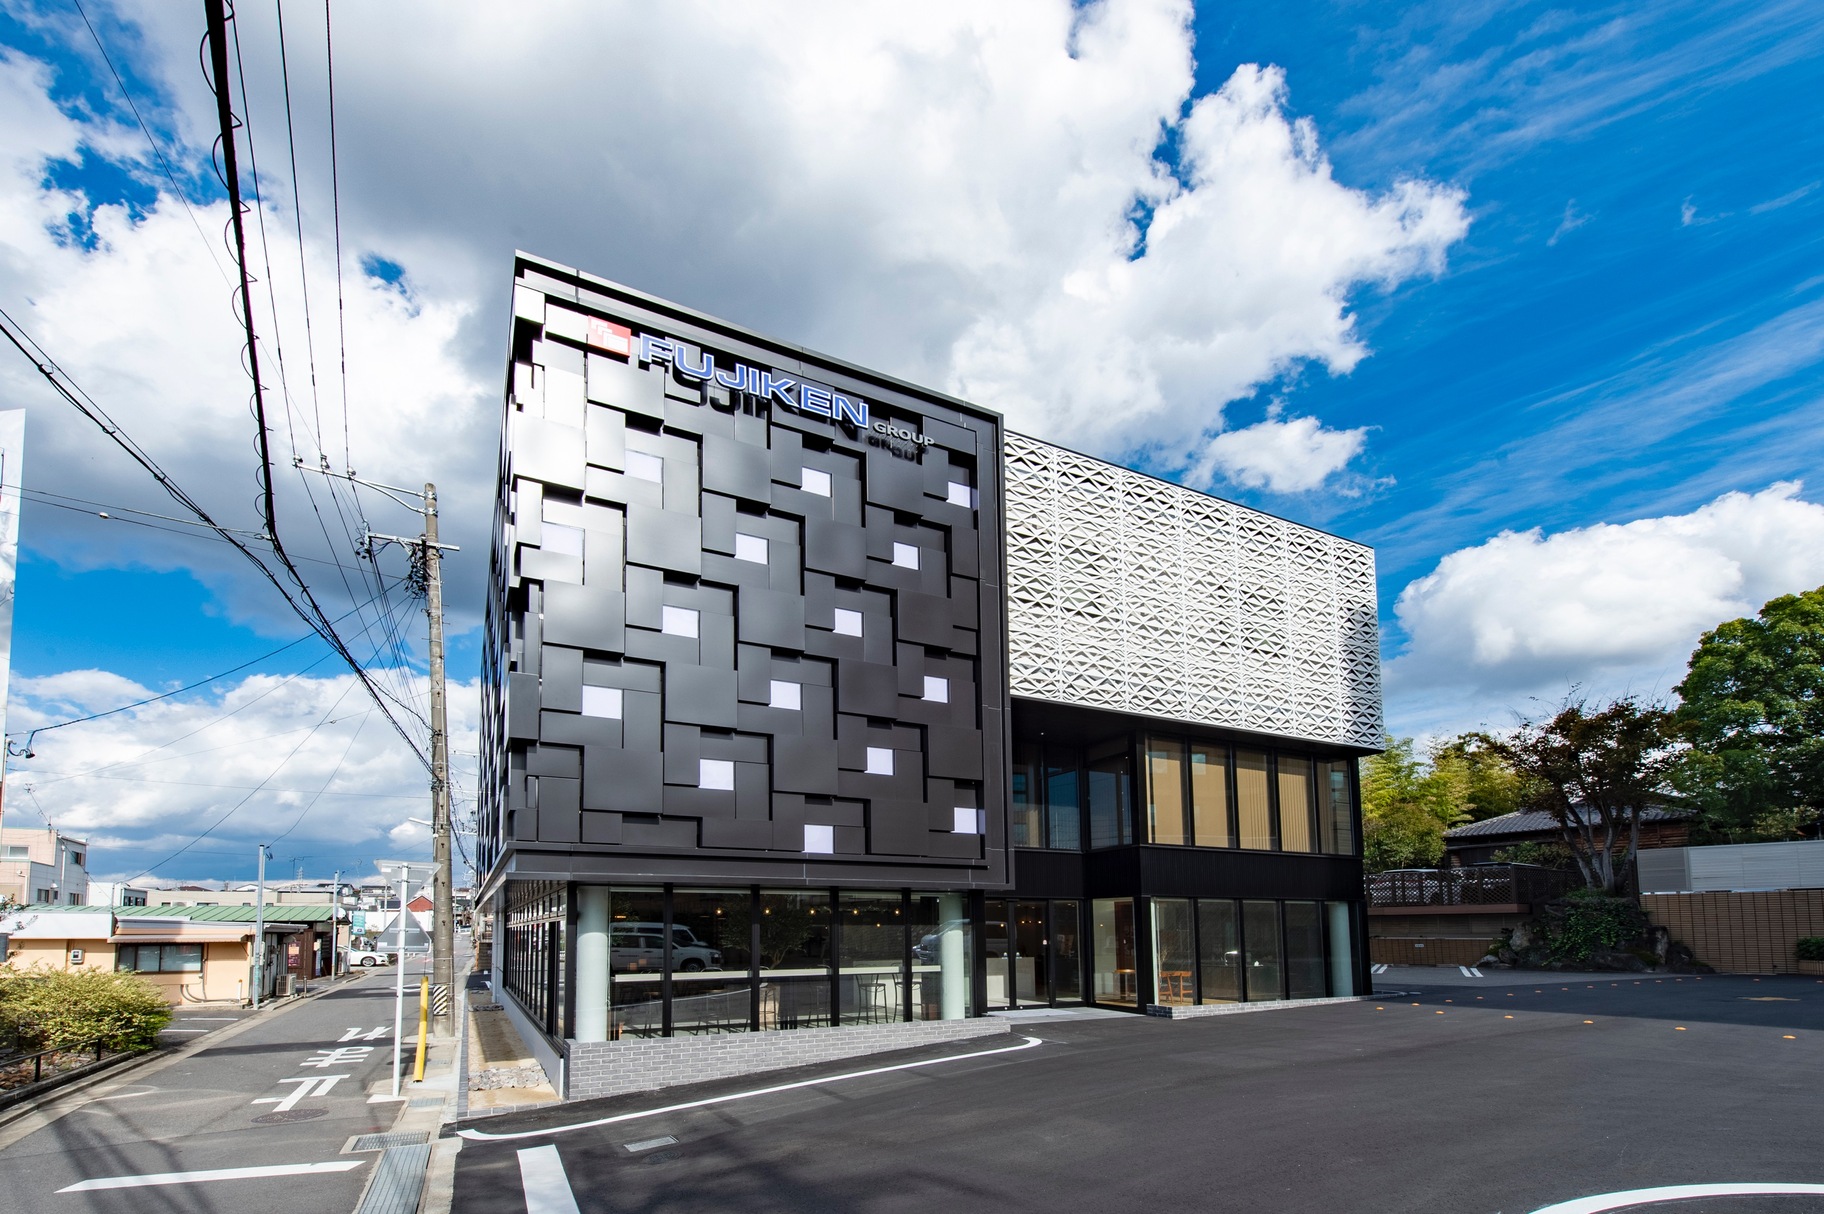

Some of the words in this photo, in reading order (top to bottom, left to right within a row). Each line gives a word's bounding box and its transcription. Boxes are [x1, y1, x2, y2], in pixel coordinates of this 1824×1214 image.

[639, 332, 869, 428] FUJIKEN
[873, 421, 935, 447] GROUP
[250, 1026, 393, 1112] 止まれ
